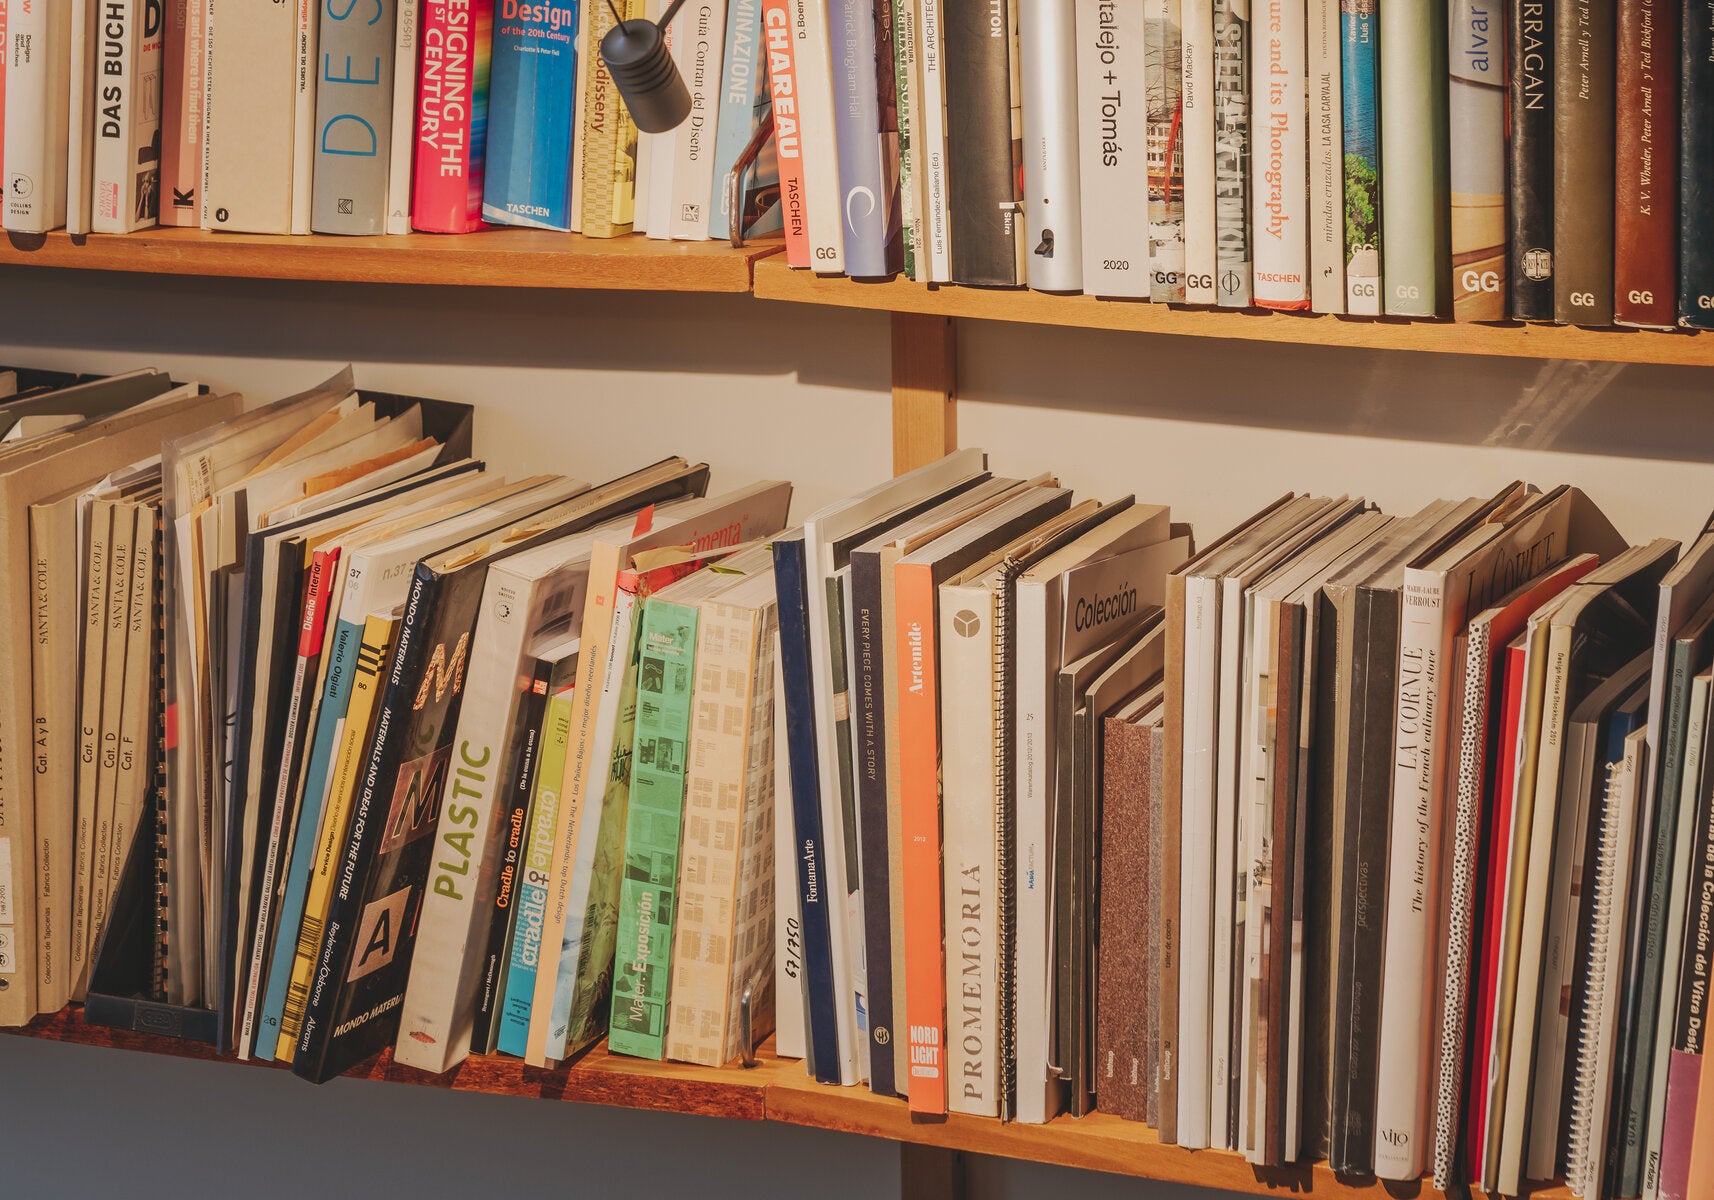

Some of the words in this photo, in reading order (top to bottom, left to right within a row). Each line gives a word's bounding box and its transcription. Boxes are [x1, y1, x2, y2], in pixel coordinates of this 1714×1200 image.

[502, 26, 511, 35] of
[512, 27, 526, 36] the
[527, 28, 546, 39] 20th
[546, 30, 571, 43] Century
[698, 6, 712, 36] Guía
[104, 2, 125, 76] BUCH
[694, 41, 709, 84] Conran
[1185, 42, 1194, 79] Mackay
[1270, 40, 1288, 75] and
[421, 29, 444, 150] CENTURY
[766, 7, 799, 159] CHAREAU
[1186, 82, 1194, 109] David
[1271, 80, 1288, 105] its
[102, 86, 122, 139] DAS
[693, 92, 704, 111] del
[690, 114, 704, 161] Diseño
[1102, 90, 1122, 167] Tomás
[440, 128, 464, 178] THE
[1265, 111, 1290, 240] Photography
[507, 203, 551, 218] TASCHEN
[787, 177, 802, 236] TASCHEN
[816, 247, 837, 260] GG
[1103, 260, 1130, 271] 2020
[1187, 274, 1213, 289] GG
[1257, 272, 1301, 283] TASCHEN
[1352, 284, 1375, 298] GG
[1462, 271, 1499, 292] GG
[1570, 292, 1595, 307] GG
[1628, 290, 1653, 304] GG
[308, 562, 322, 597] Interior
[350, 568, 361, 579] 37
[303, 598, 316, 631] Diseño
[407, 578, 423, 626] MONDO
[1075, 582, 1137, 632] Colección
[861, 609, 870, 641] EVERY
[336, 630, 350, 663] Valerio
[391, 626, 413, 686] MATERIALIS
[863, 644, 872, 672] PIECE
[908, 622, 923, 696] Artemide
[329, 666, 342, 699] Olgiati
[1426, 650, 1436, 683] stove
[864, 674, 874, 708] COMES
[865, 711, 875, 738] WITH
[1422, 687, 1437, 743] culinary
[373, 707, 392, 763] MATERIALS
[867, 739, 874, 747] A
[867, 749, 876, 781] STORY
[1398, 744, 1417, 770] LA
[1418, 747, 1431, 792] French
[367, 763, 379, 787] AND
[359, 787, 372, 819] IDEAS
[1417, 797, 1428, 816] the
[352, 818, 365, 839] FOR
[434, 740, 491, 901] PLASTIC
[509, 808, 524, 848] cradle
[1416, 819, 1429, 834] of
[346, 839, 358, 862] THE
[506, 850, 517, 863] to
[1413, 837, 1428, 885] history
[339, 860, 355, 900] FUTURE
[496, 866, 514, 909] Cradle
[804, 839, 818, 903] FontanaArte
[1412, 889, 1423, 912] The
[522, 889, 547, 967] cradle
[961, 864, 983, 1101] PROMEMORIA
[911, 1025, 939, 1045] NORD
[911, 1047, 939, 1066] LIGHT
